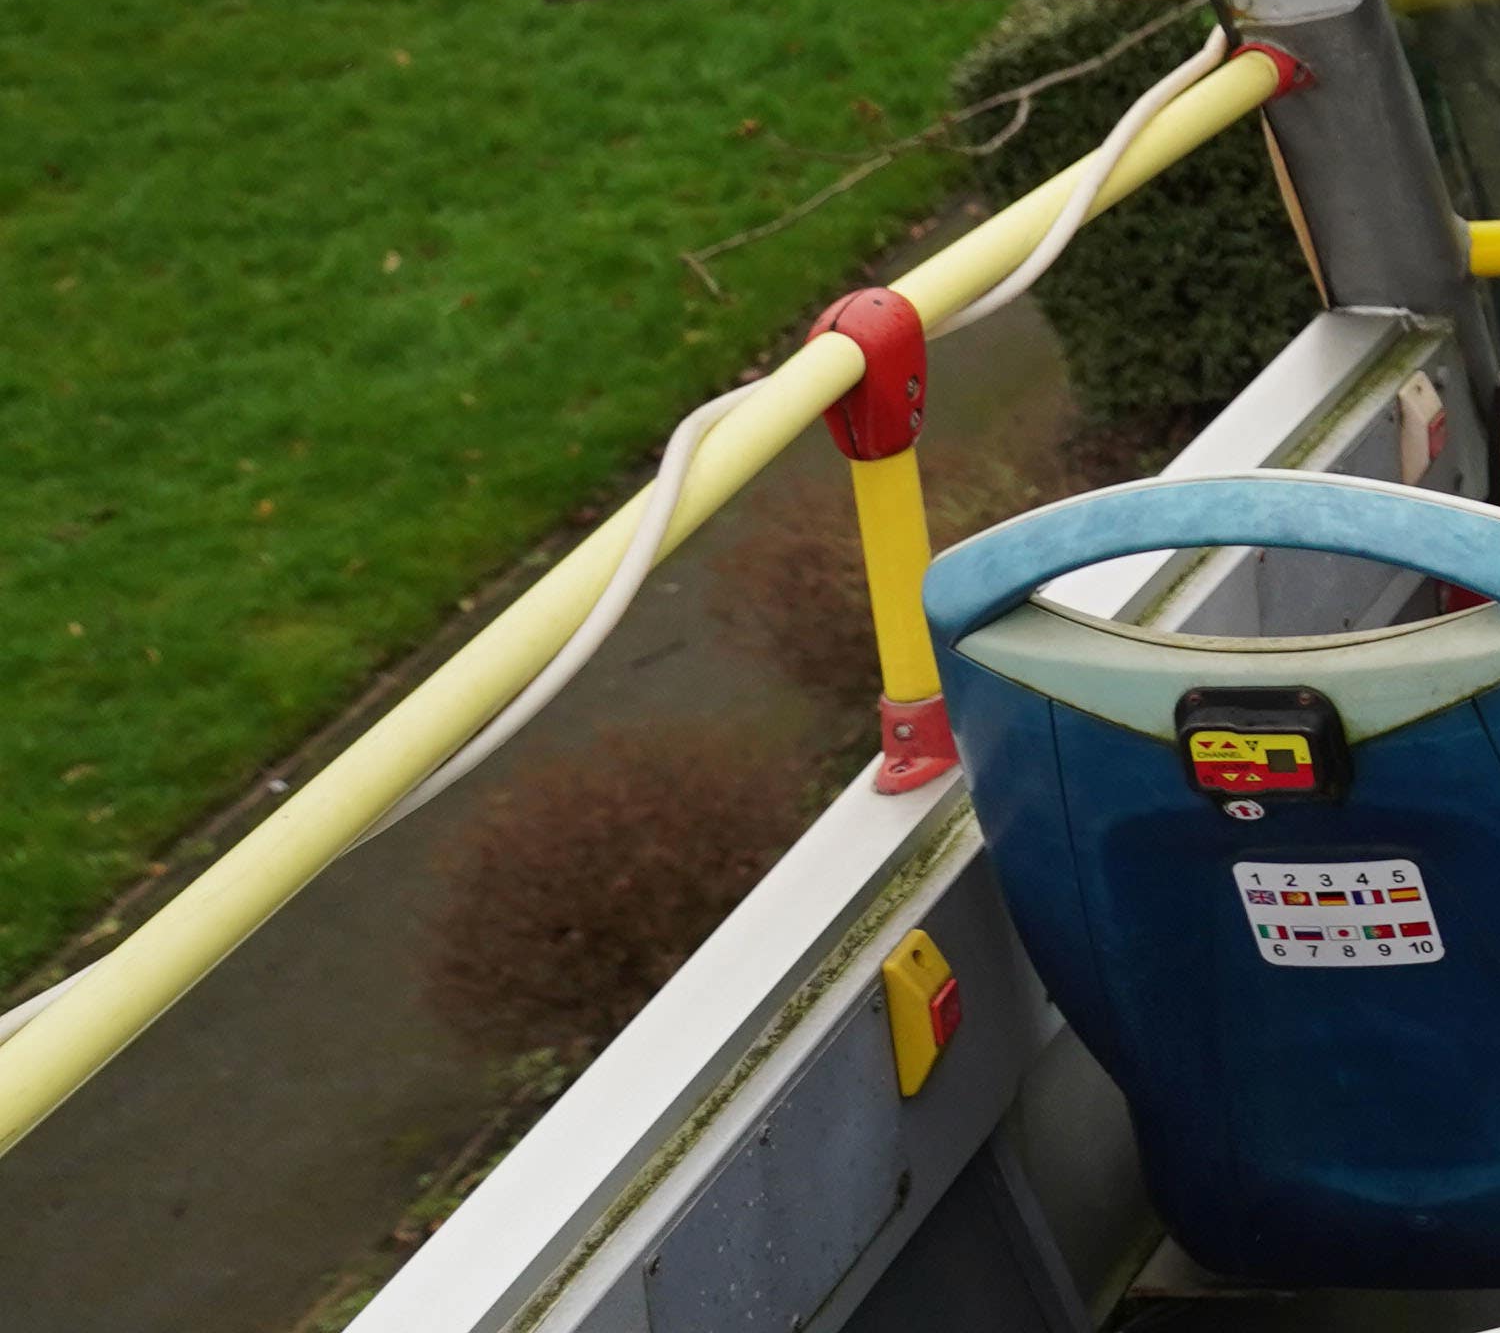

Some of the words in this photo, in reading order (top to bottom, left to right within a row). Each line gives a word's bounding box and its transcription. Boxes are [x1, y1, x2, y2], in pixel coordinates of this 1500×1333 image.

[1251, 873, 1262, 886] 1
[1284, 874, 1298, 887] 2
[1319, 874, 1333, 887] 3
[1356, 873, 1370, 885] 4
[1392, 870, 1406, 883] 5
[1273, 944, 1287, 957] 6
[1306, 945, 1318, 957] 7
[1342, 945, 1356, 957] 8
[1377, 944, 1391, 957] 9
[1408, 940, 1434, 954] 10
